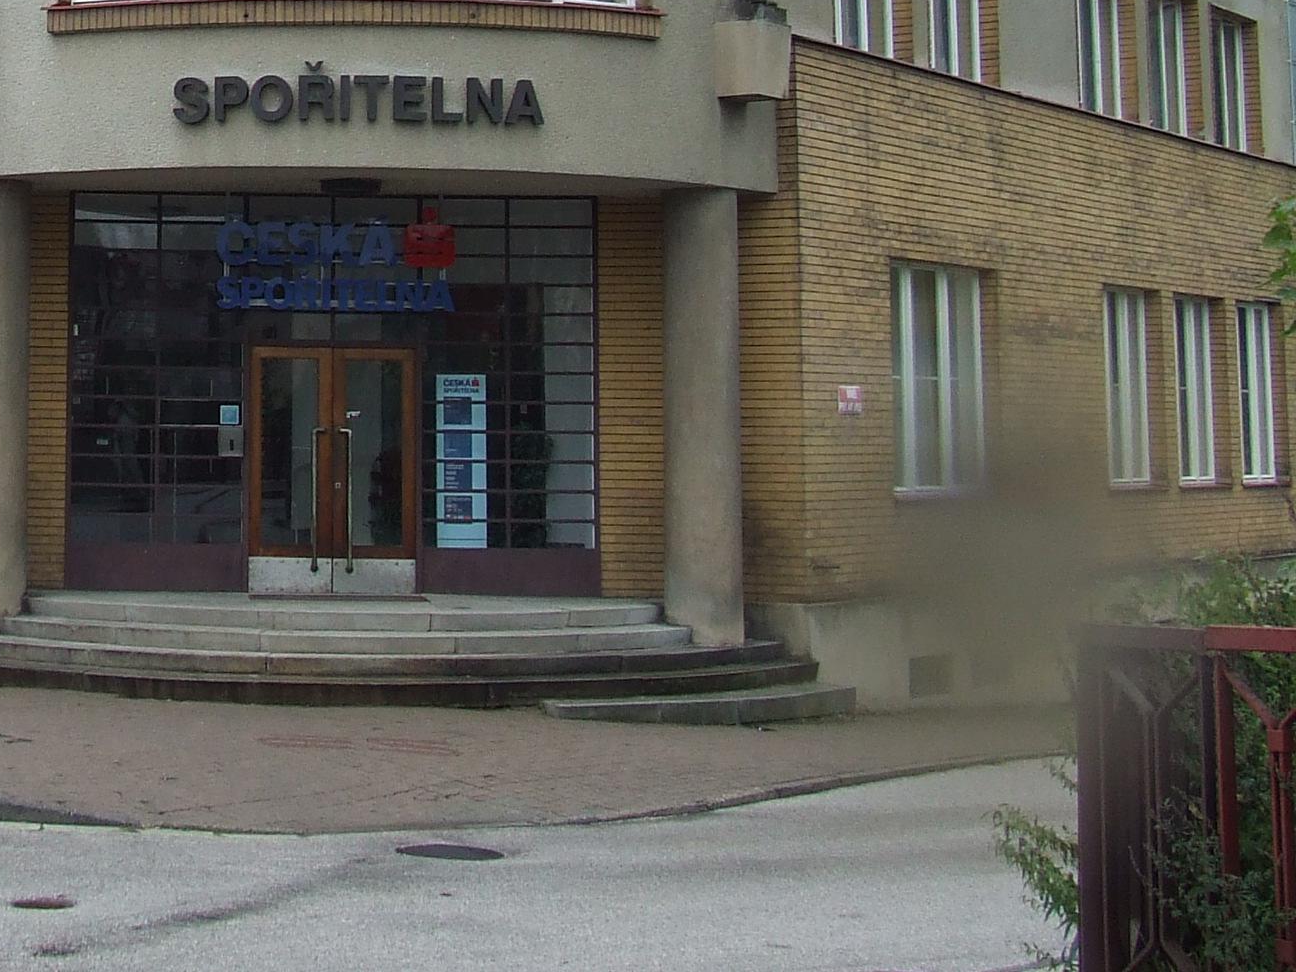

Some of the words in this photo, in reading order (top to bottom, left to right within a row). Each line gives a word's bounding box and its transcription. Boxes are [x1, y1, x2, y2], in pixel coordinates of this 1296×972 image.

[172, 60, 545, 125] SPOŘITELNA
[216, 212, 396, 267] ČESKÁ
[216, 271, 454, 312] SPOŘITELNA
